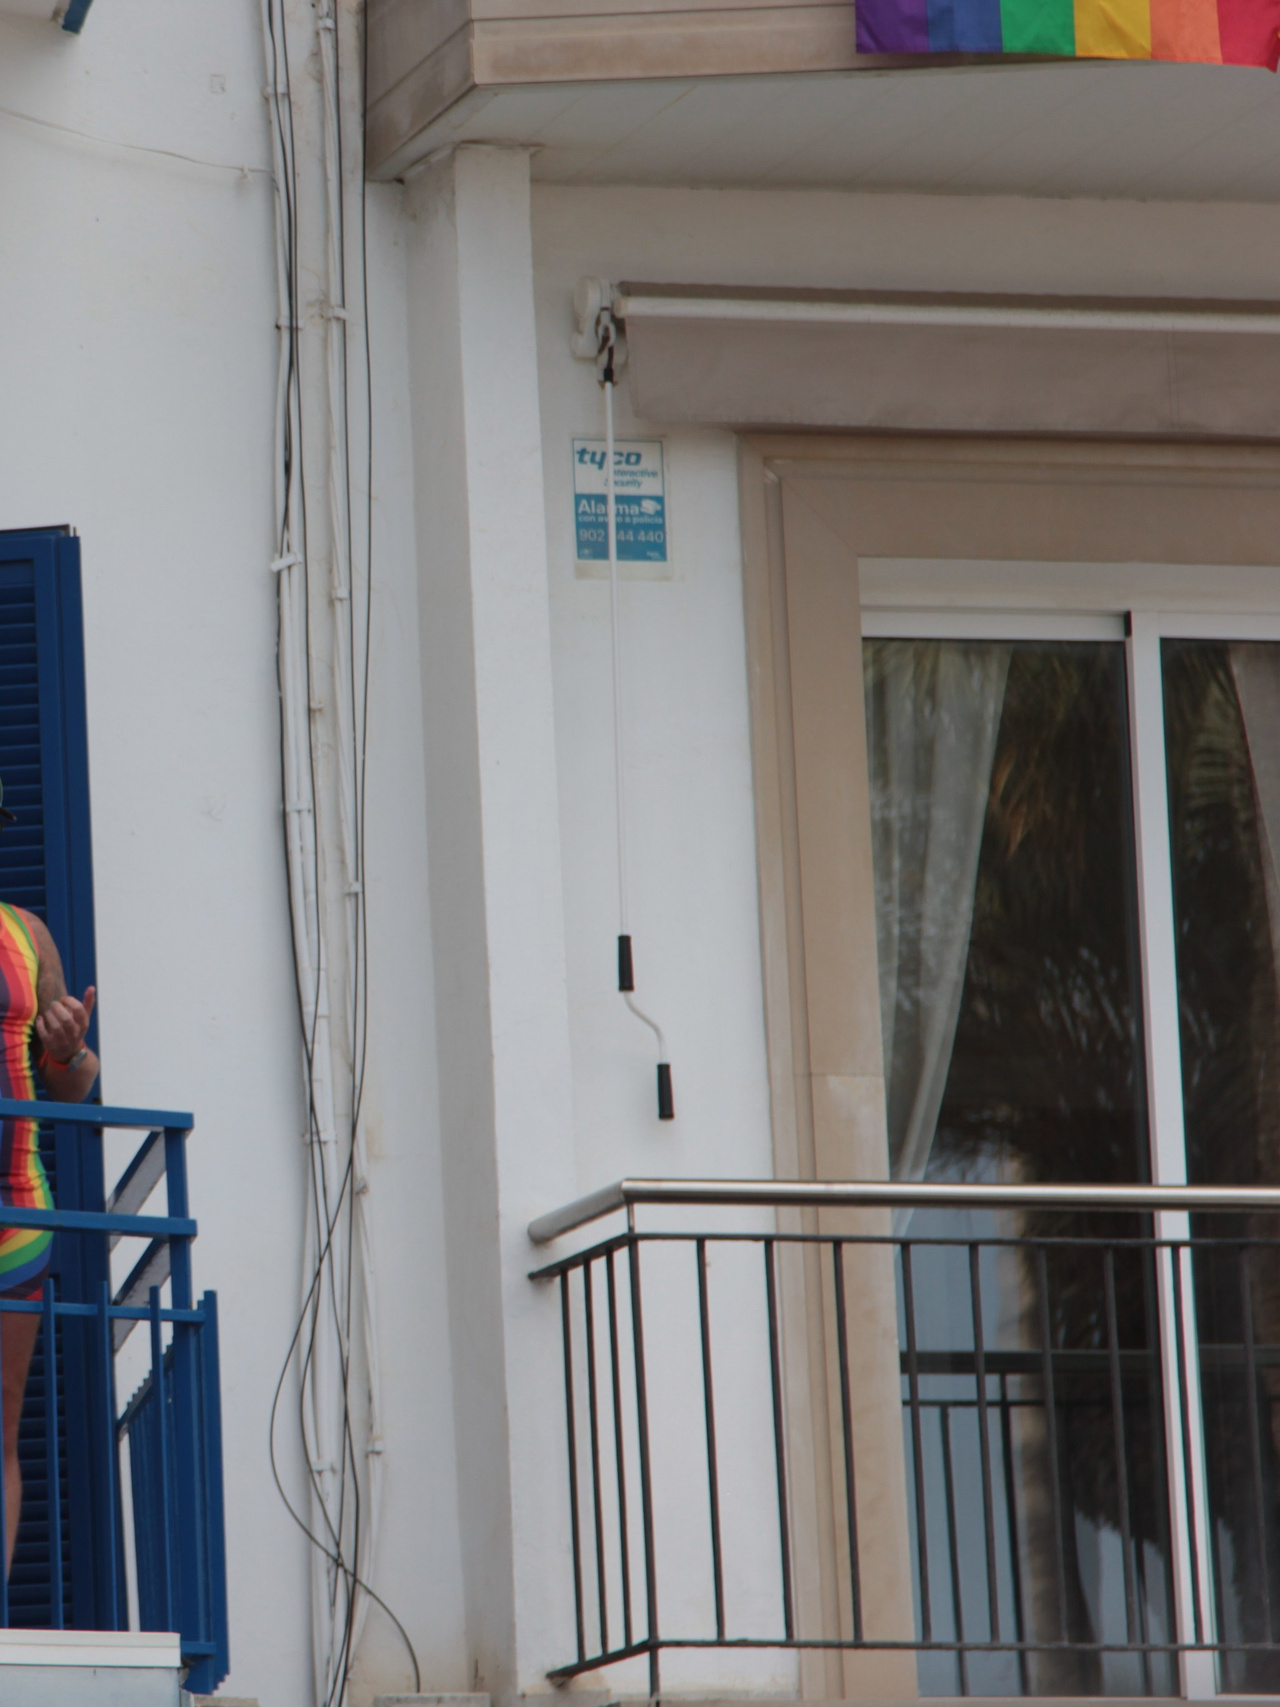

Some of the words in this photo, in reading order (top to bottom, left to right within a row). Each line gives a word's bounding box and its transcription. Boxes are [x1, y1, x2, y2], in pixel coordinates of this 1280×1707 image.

[576, 447, 642, 470] tyco
[577, 498, 640, 515] Alama
[579, 528, 605, 542] 902
[613, 529, 634, 542] 44
[637, 530, 664, 543] 440
